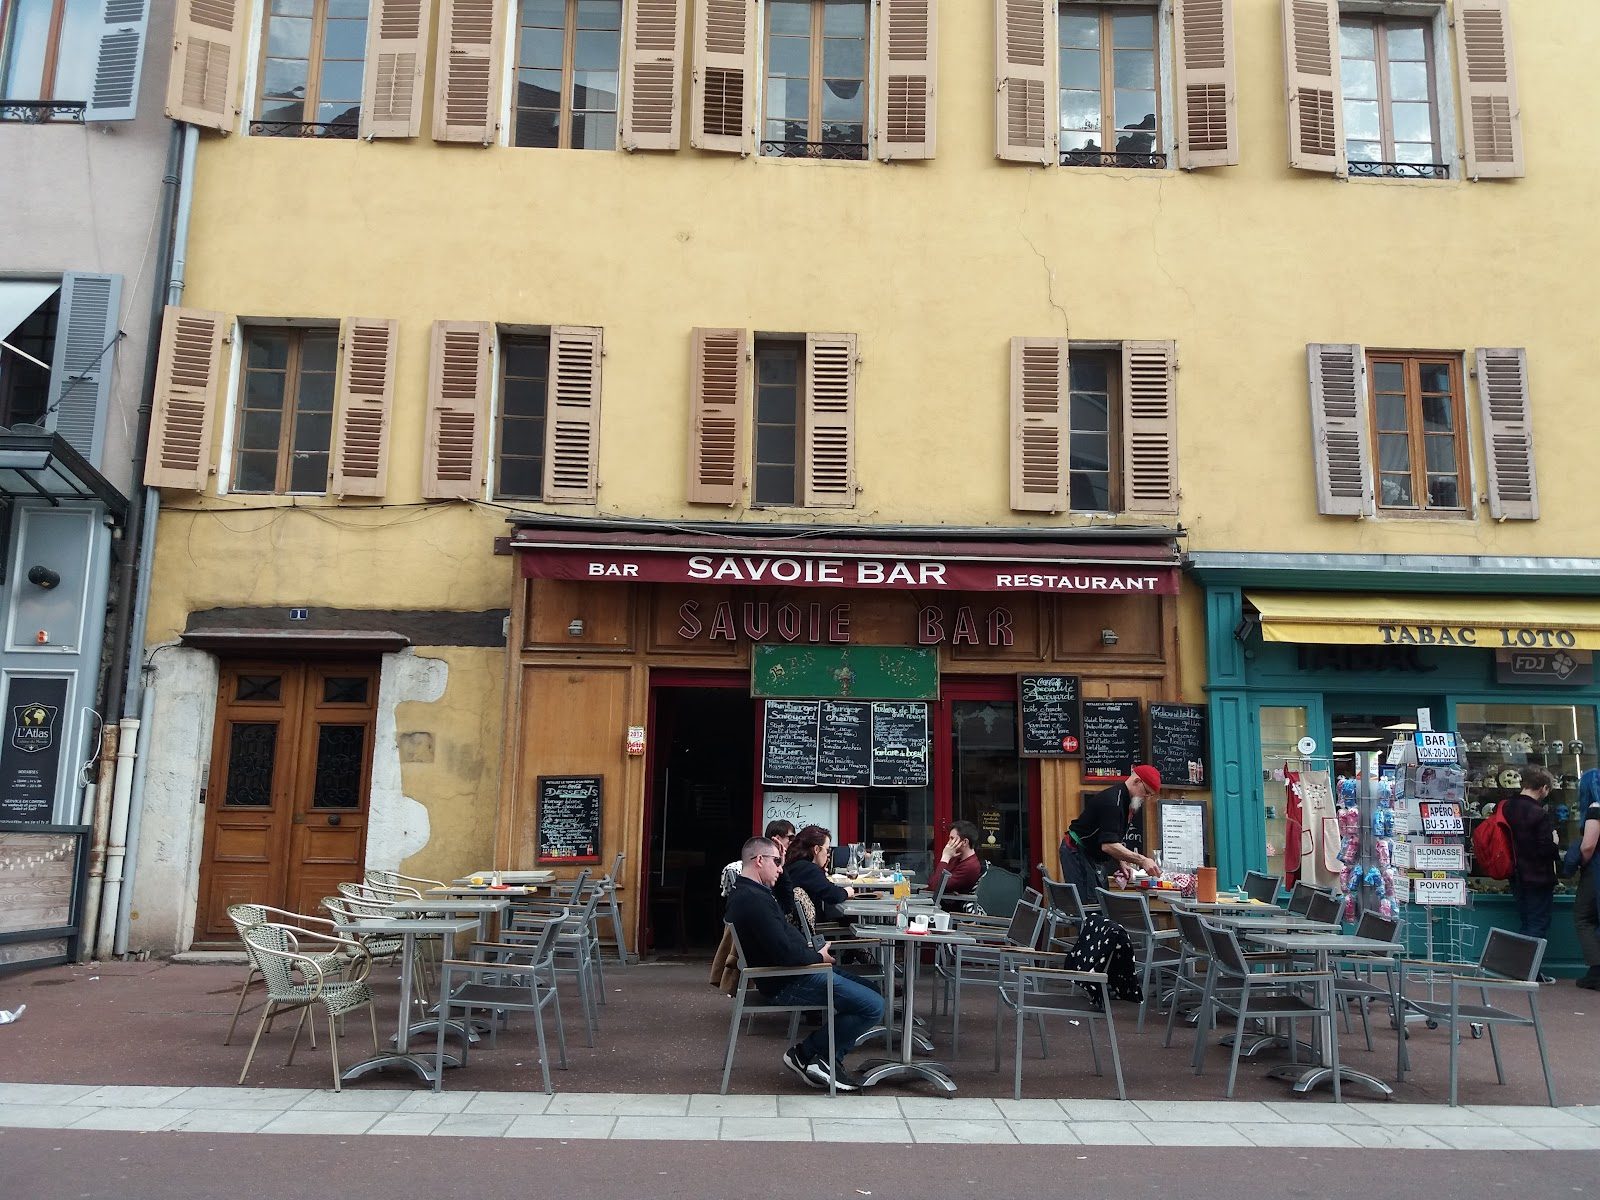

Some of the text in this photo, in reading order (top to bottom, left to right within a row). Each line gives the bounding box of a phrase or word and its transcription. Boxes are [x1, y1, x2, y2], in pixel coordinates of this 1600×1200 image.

[588, 562, 639, 577] BAR
[687, 556, 947, 585] SAVOIE BAR
[996, 574, 1158, 590] RESTAURANT
[917, 605, 1014, 646] BAR
[1379, 625, 1576, 648] TABAC LOTO
[1516, 656, 1546, 670] FDJ
[17, 727, 49, 738] L'Atlas
[1424, 735, 1446, 746] BAR
[1430, 804, 1453, 817] APÉRO
[1425, 819, 1462, 829] BU-51-JB
[1416, 848, 1461, 856] BLONDASSE
[1419, 881, 1460, 889] POIVROT
